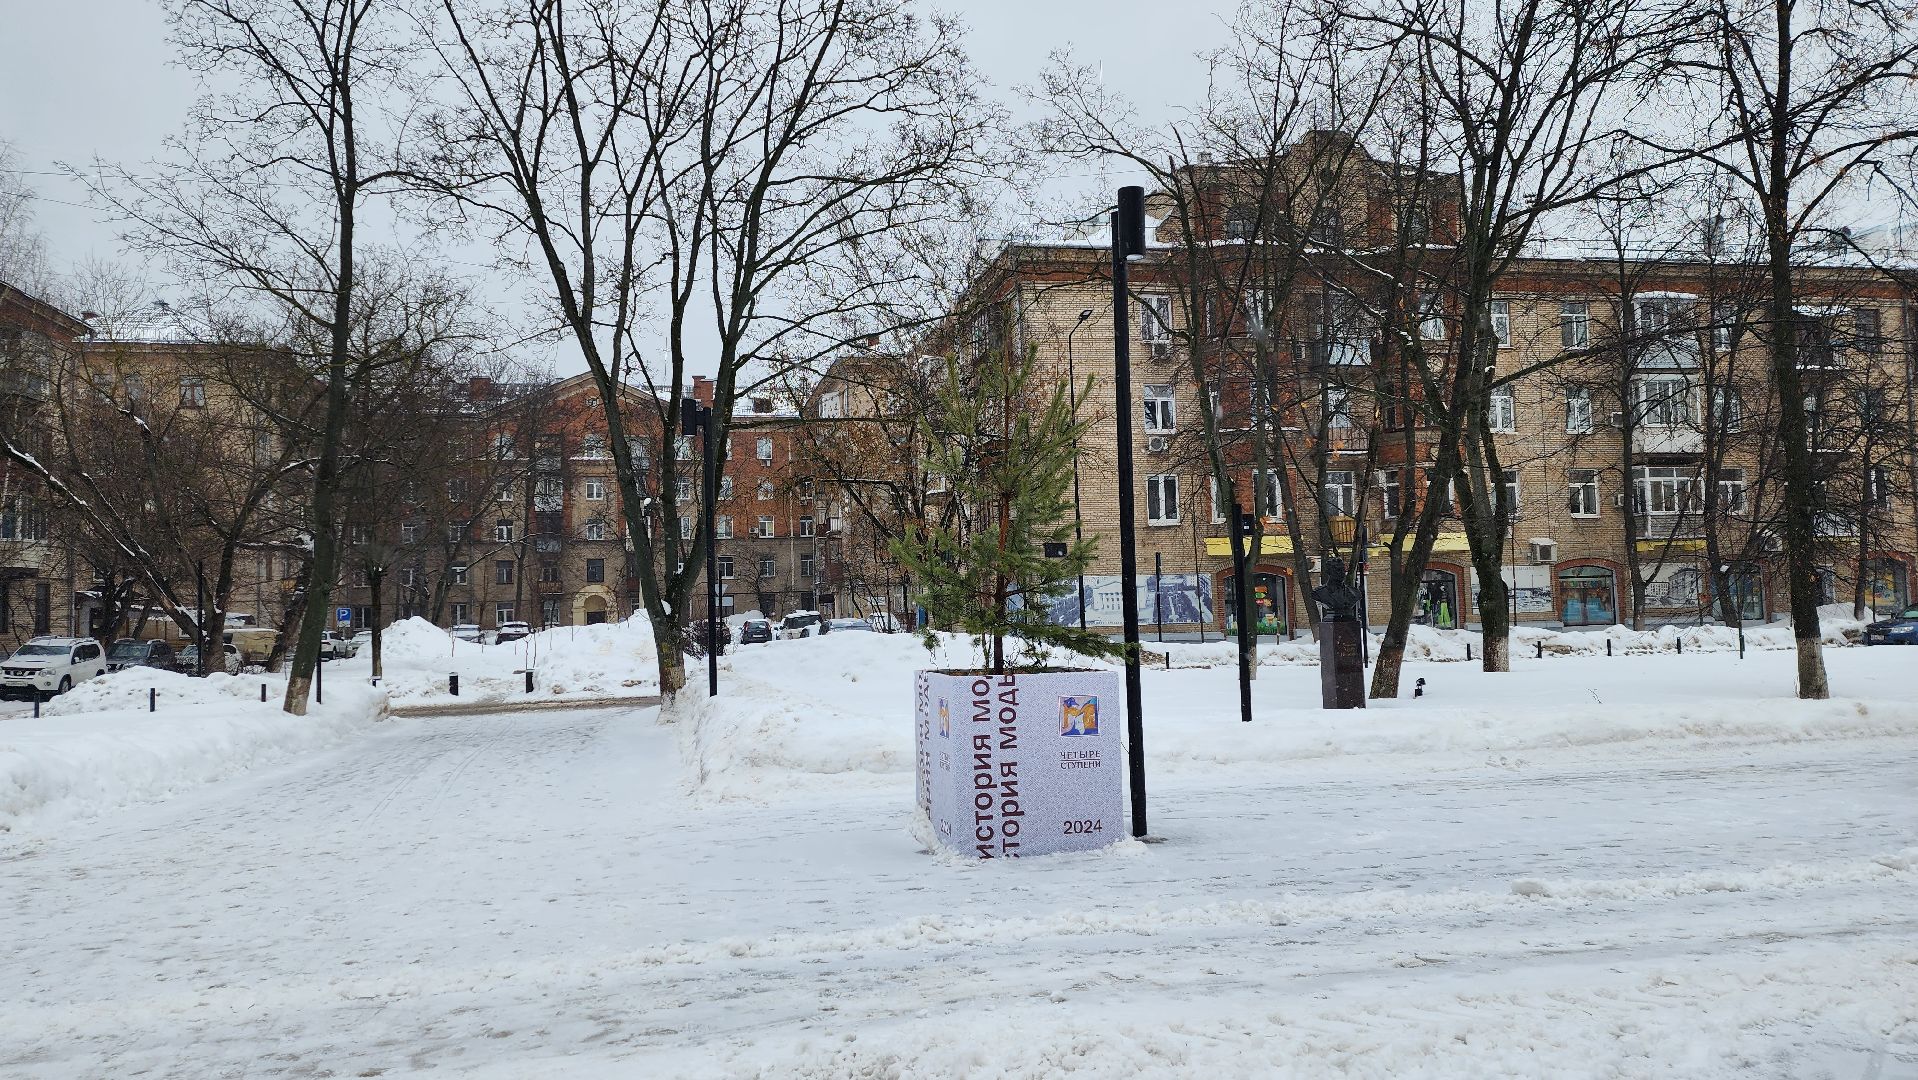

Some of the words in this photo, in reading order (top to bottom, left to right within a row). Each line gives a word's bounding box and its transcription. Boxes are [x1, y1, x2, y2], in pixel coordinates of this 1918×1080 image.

[339, 609, 349, 620] P
[971, 675, 994, 722] МО
[1060, 750, 1101, 759] ЧЕТЫРЕ
[1060, 761, 1101, 769] СТУПЕНИ
[1000, 761, 1025, 858] ТОРИЯ
[1063, 820, 1103, 835] 2024
